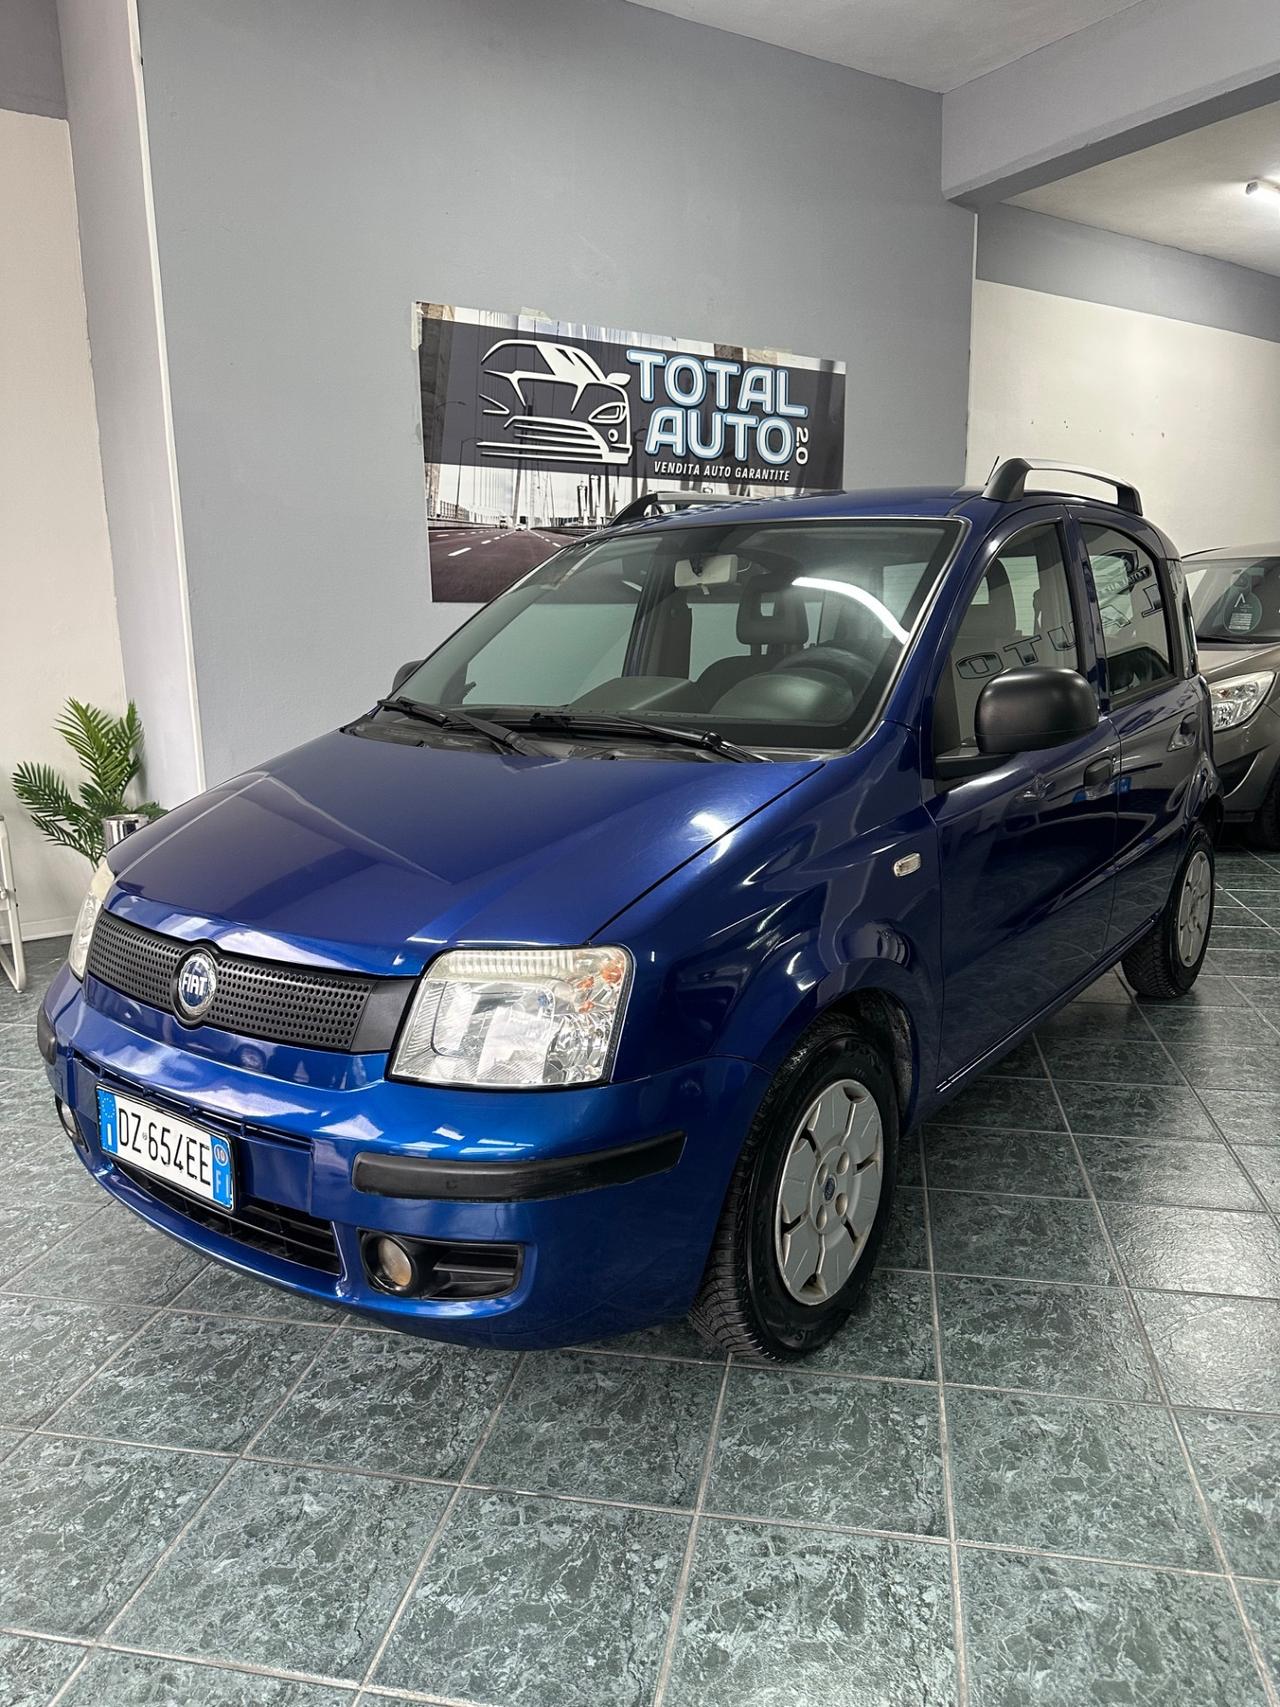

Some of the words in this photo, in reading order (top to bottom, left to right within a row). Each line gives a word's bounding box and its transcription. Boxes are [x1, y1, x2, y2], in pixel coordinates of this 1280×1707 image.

[626, 350, 808, 418] TOTAL
[645, 406, 794, 465] AUTO
[796, 426, 809, 465] 2.0
[654, 461, 700, 475] VENDITA
[704, 465, 731, 478] AUTO
[735, 467, 790, 481] GARANTITE
[181, 972, 208, 996] FIAT
